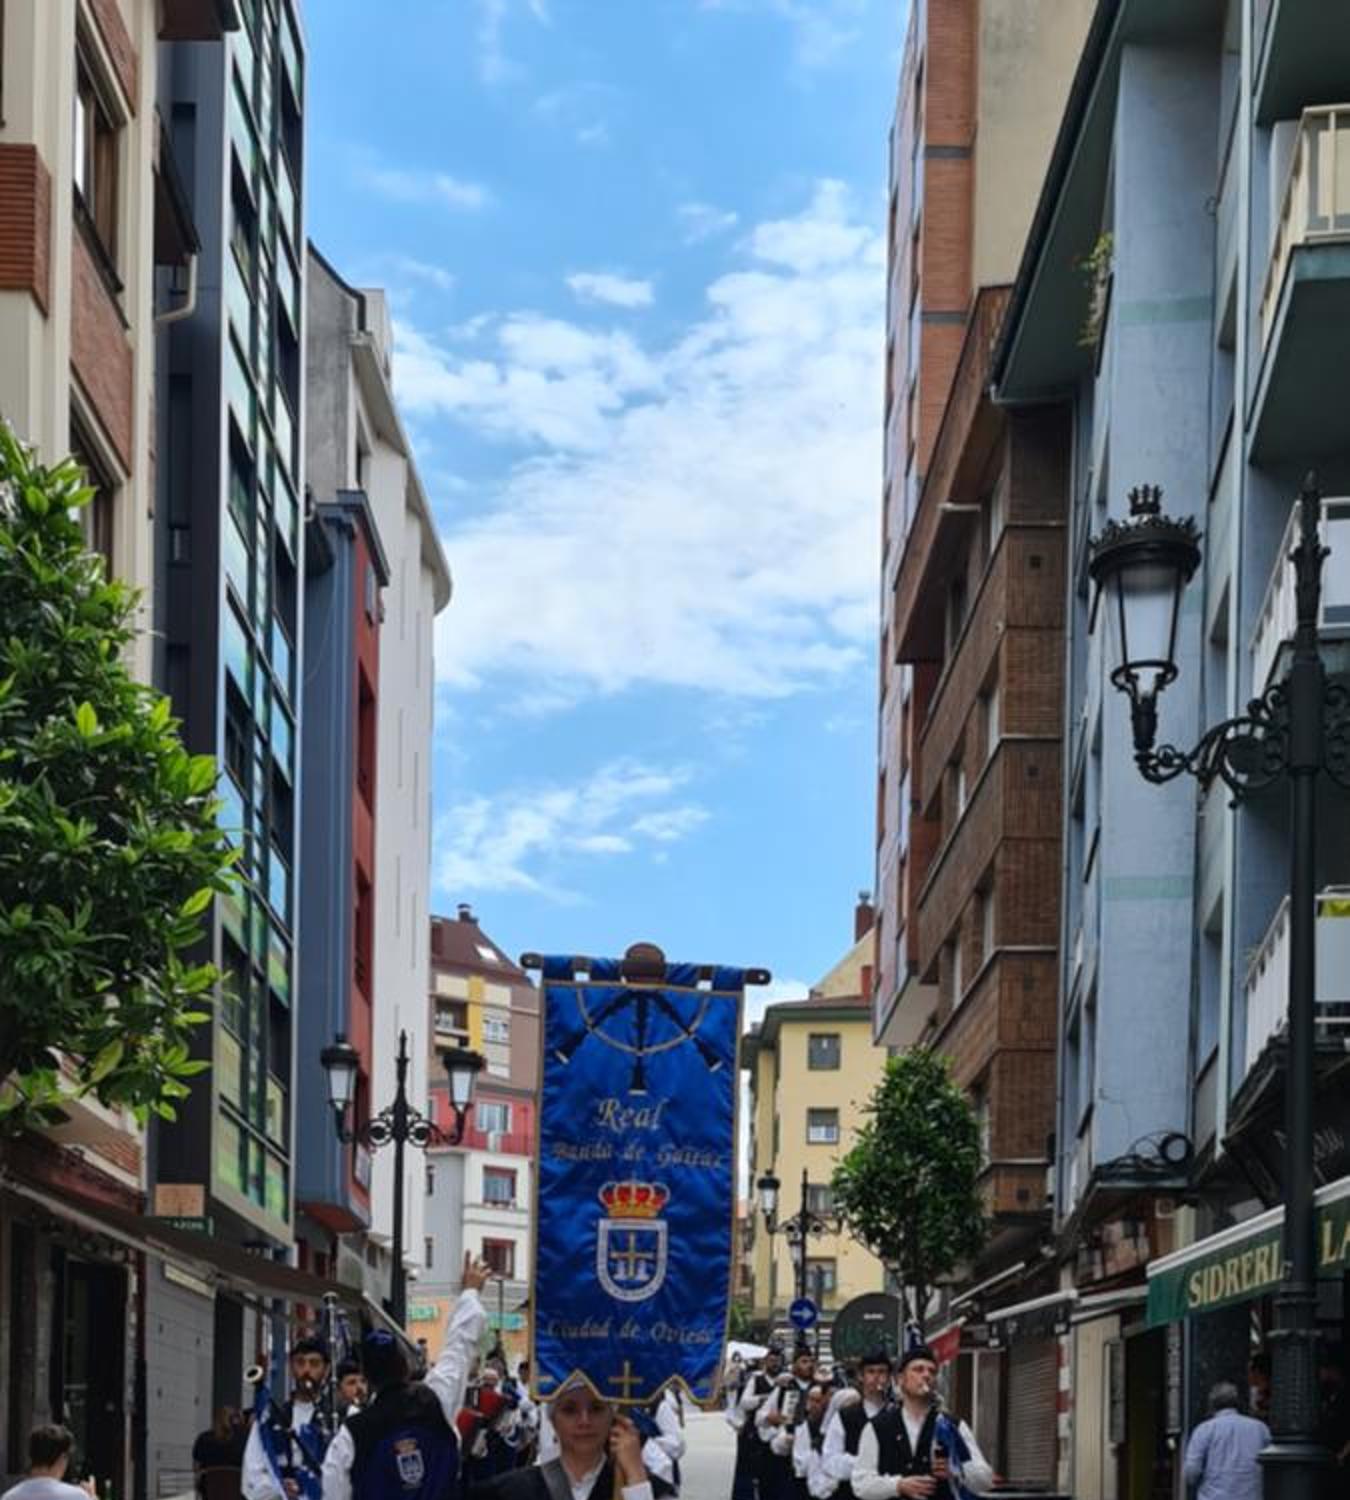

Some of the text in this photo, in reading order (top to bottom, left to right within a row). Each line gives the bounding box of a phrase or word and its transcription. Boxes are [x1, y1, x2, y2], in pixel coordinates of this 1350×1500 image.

[595, 1098, 669, 1133] Real
[624, 1139, 645, 1161] de
[1188, 1241, 1284, 1308] SIDRERI
[548, 1313, 612, 1337] Ciudad
[620, 1313, 641, 1339] de
